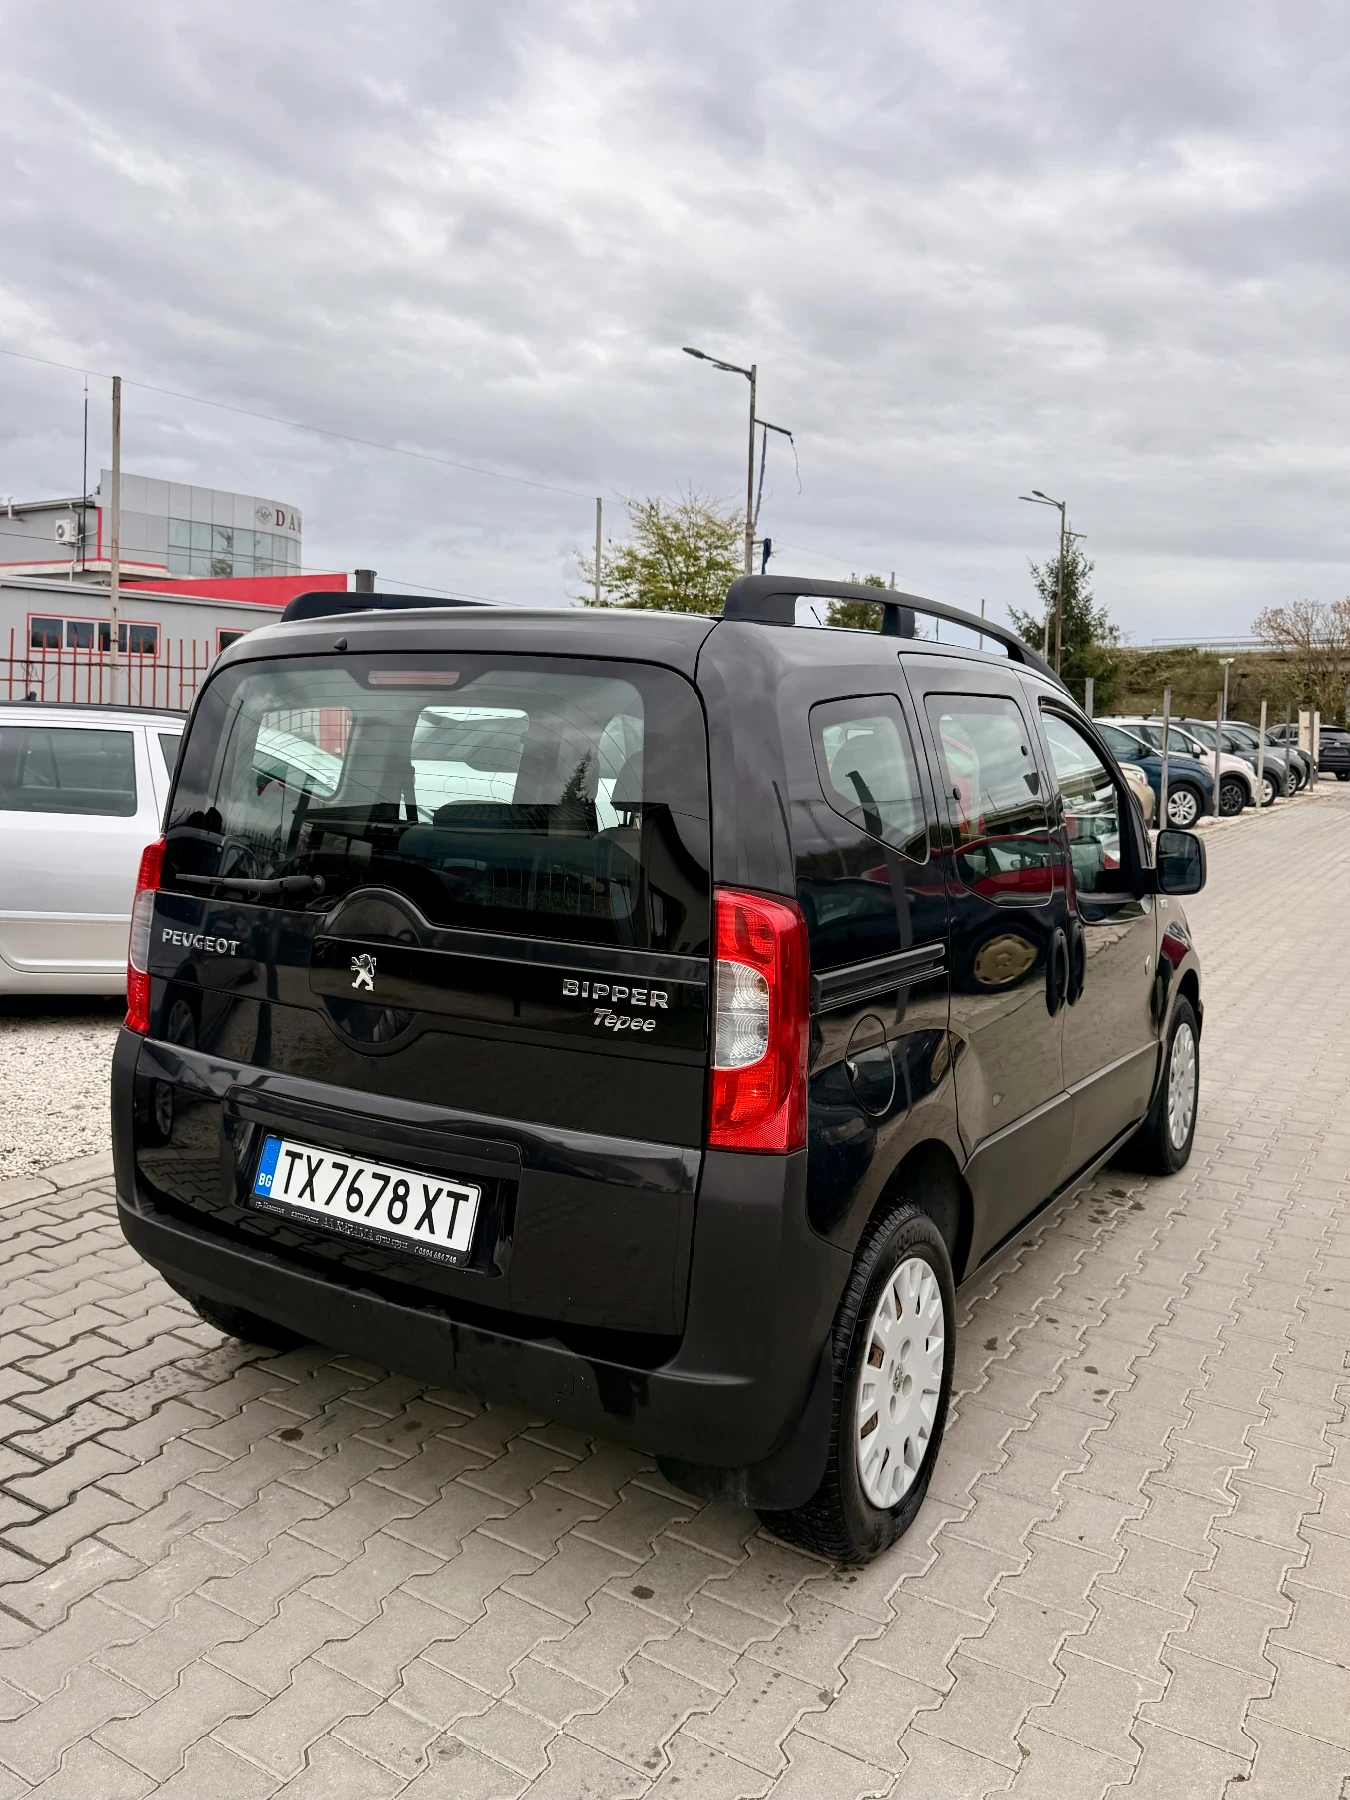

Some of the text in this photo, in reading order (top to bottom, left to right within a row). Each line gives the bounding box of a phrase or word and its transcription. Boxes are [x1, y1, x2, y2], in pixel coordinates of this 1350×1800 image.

[162, 928, 241, 956] PEUGEOT
[562, 979, 668, 1009] BIPPER
[593, 1007, 656, 1032] Tepee
[257, 1172, 273, 1188] BG
